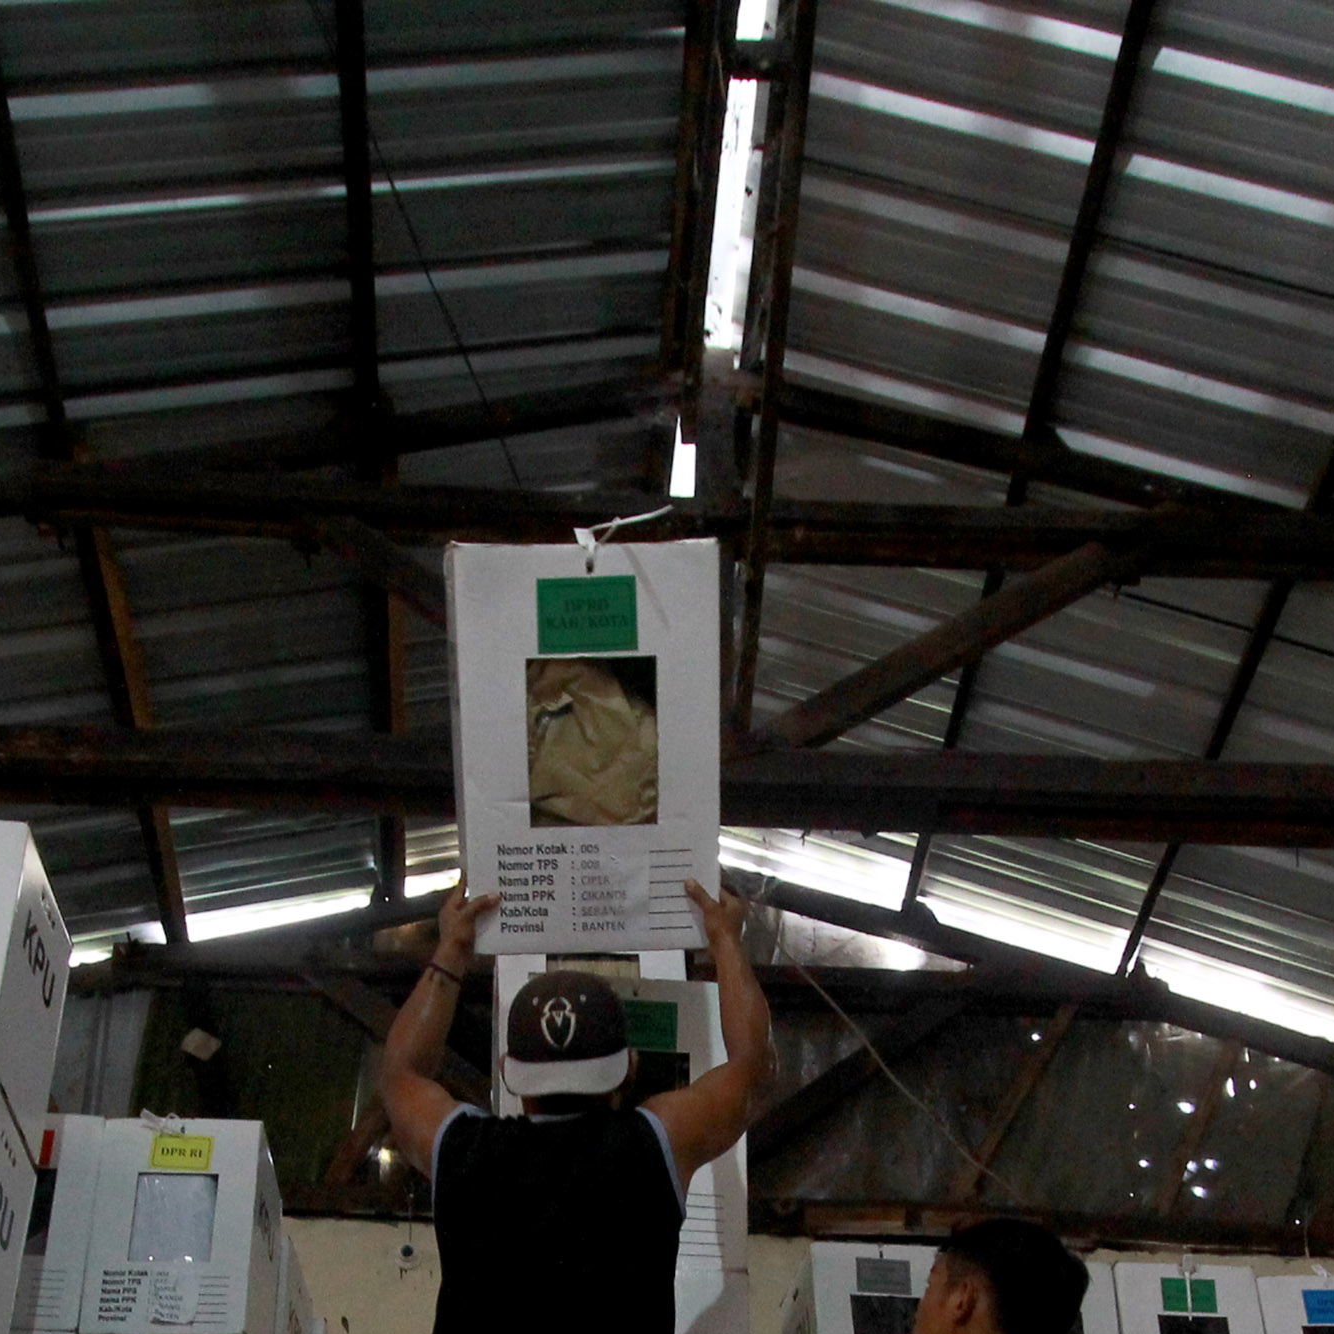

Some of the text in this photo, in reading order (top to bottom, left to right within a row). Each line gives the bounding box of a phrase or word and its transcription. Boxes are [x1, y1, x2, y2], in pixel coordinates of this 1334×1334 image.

[497, 844, 533, 856] Nomor
[537, 843, 568, 855] Kotak
[498, 860, 534, 870] Nomor
[537, 859, 558, 870] TPS
[499, 876, 529, 886] Nama
[532, 875, 554, 886] PPS
[499, 891, 529, 901] Nama
[532, 891, 555, 901] PPK
[501, 921, 626, 933] Provinsi BANTEN
[22, 909, 55, 1009] KPU
[161, 1147, 203, 1159] DPR RI
